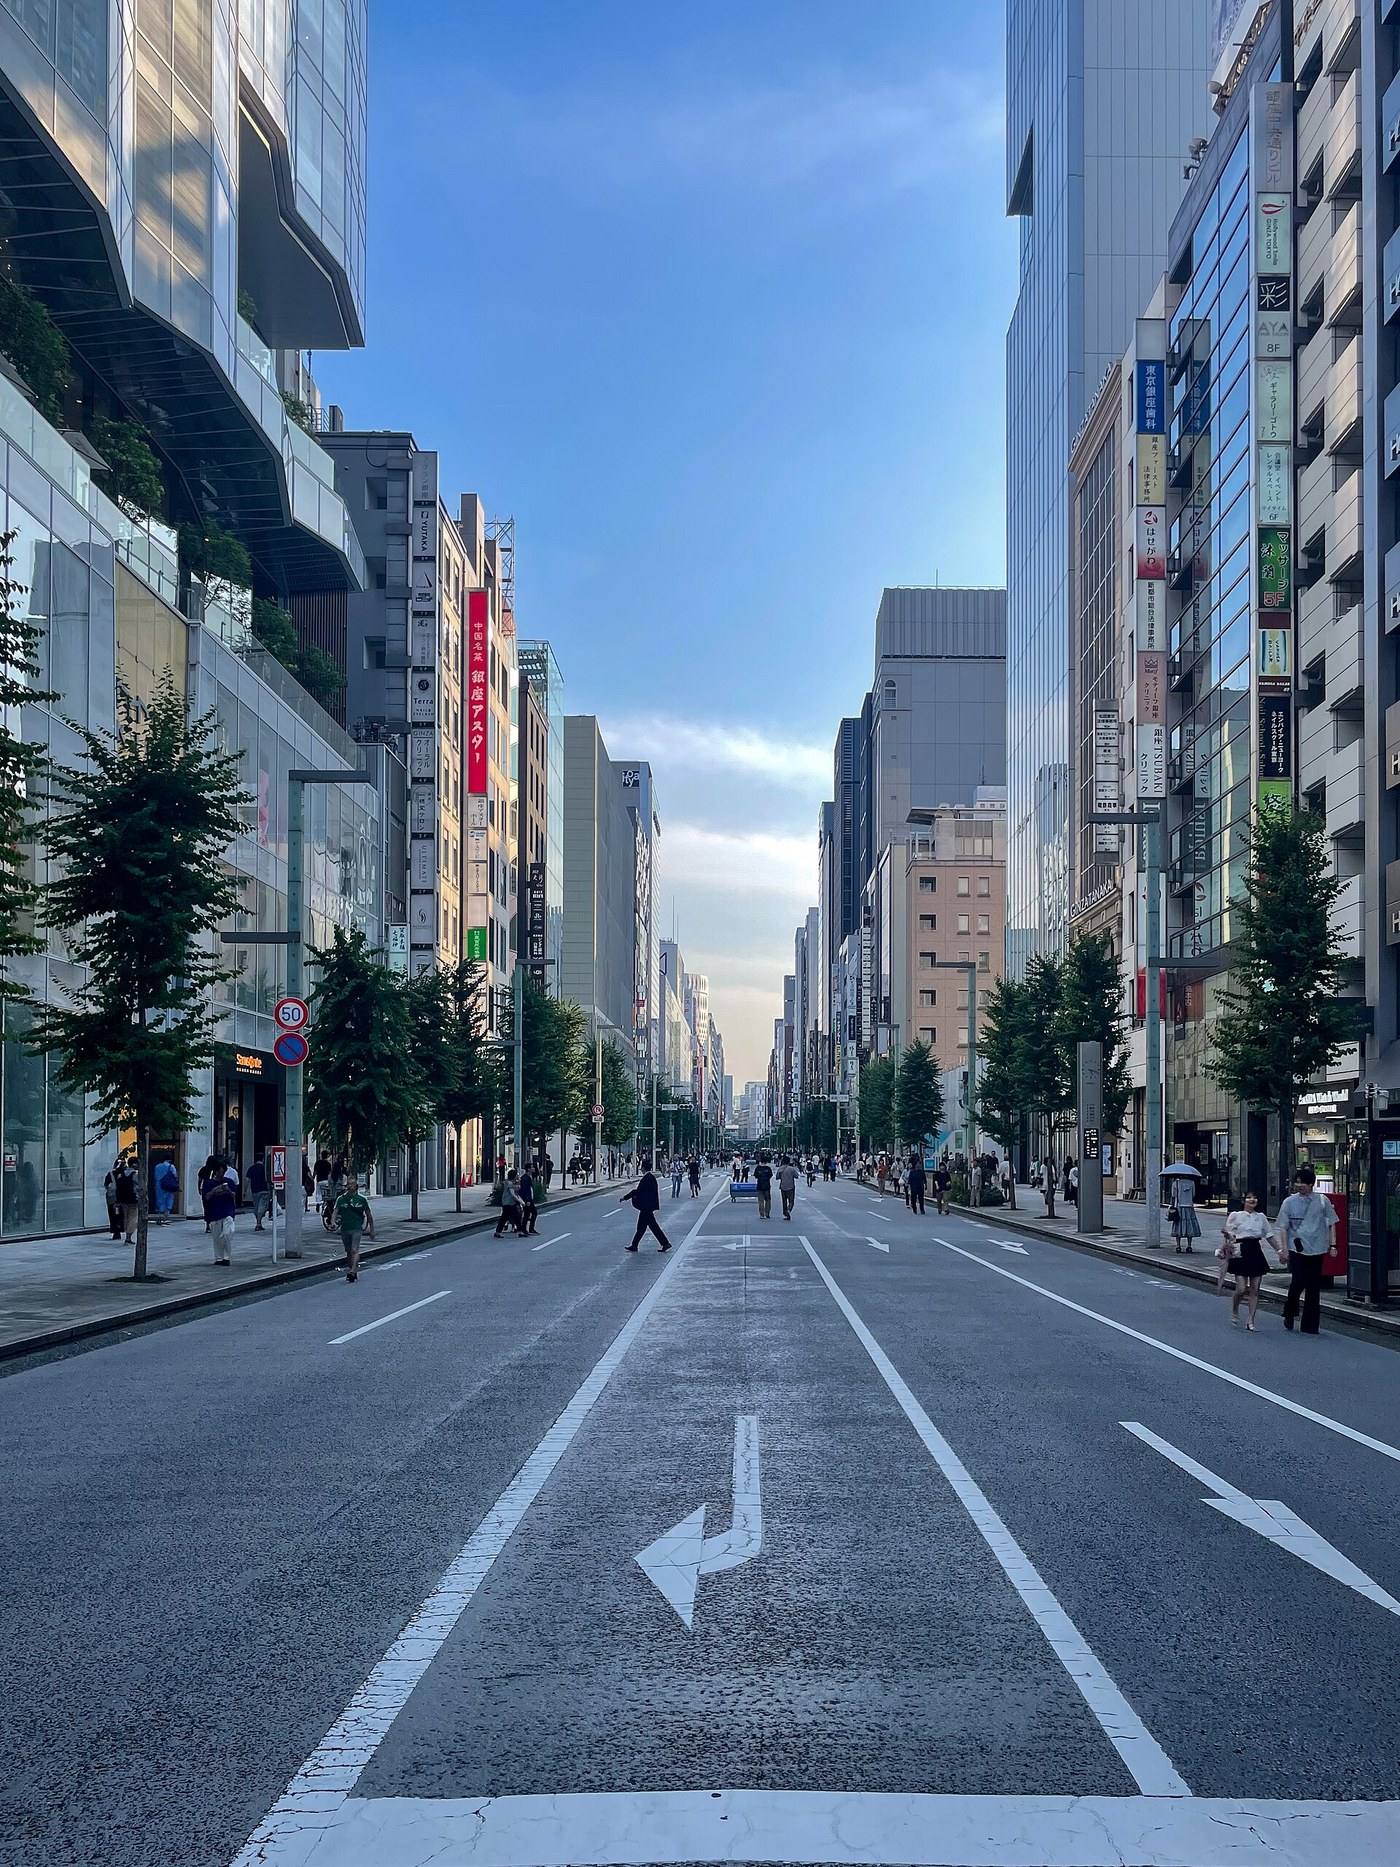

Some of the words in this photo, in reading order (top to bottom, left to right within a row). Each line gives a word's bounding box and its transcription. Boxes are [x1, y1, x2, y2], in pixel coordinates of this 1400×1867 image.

[1260, 281, 1287, 308] 彩
[1258, 322, 1288, 332] AYA
[1266, 344, 1280, 353] 8F
[1145, 365, 1157, 430] 東京銀座歯科
[1269, 513, 1279, 521] 6F
[1146, 527, 1156, 565] はせがわ
[1263, 591, 1285, 607] 5F
[473, 622, 484, 662] 中国名菜
[413, 697, 434, 705] Terra
[471, 669, 485, 764] 銀座アスター
[1140, 753, 1148, 793] クリニック
[1154, 746, 1163, 793] TSUBAKI
[1070, 895, 1090, 917] GINZA
[1088, 879, 1114, 905] TANAKA
[281, 1006, 301, 1022] 50
[236, 1053, 262, 1069] Samsonite
